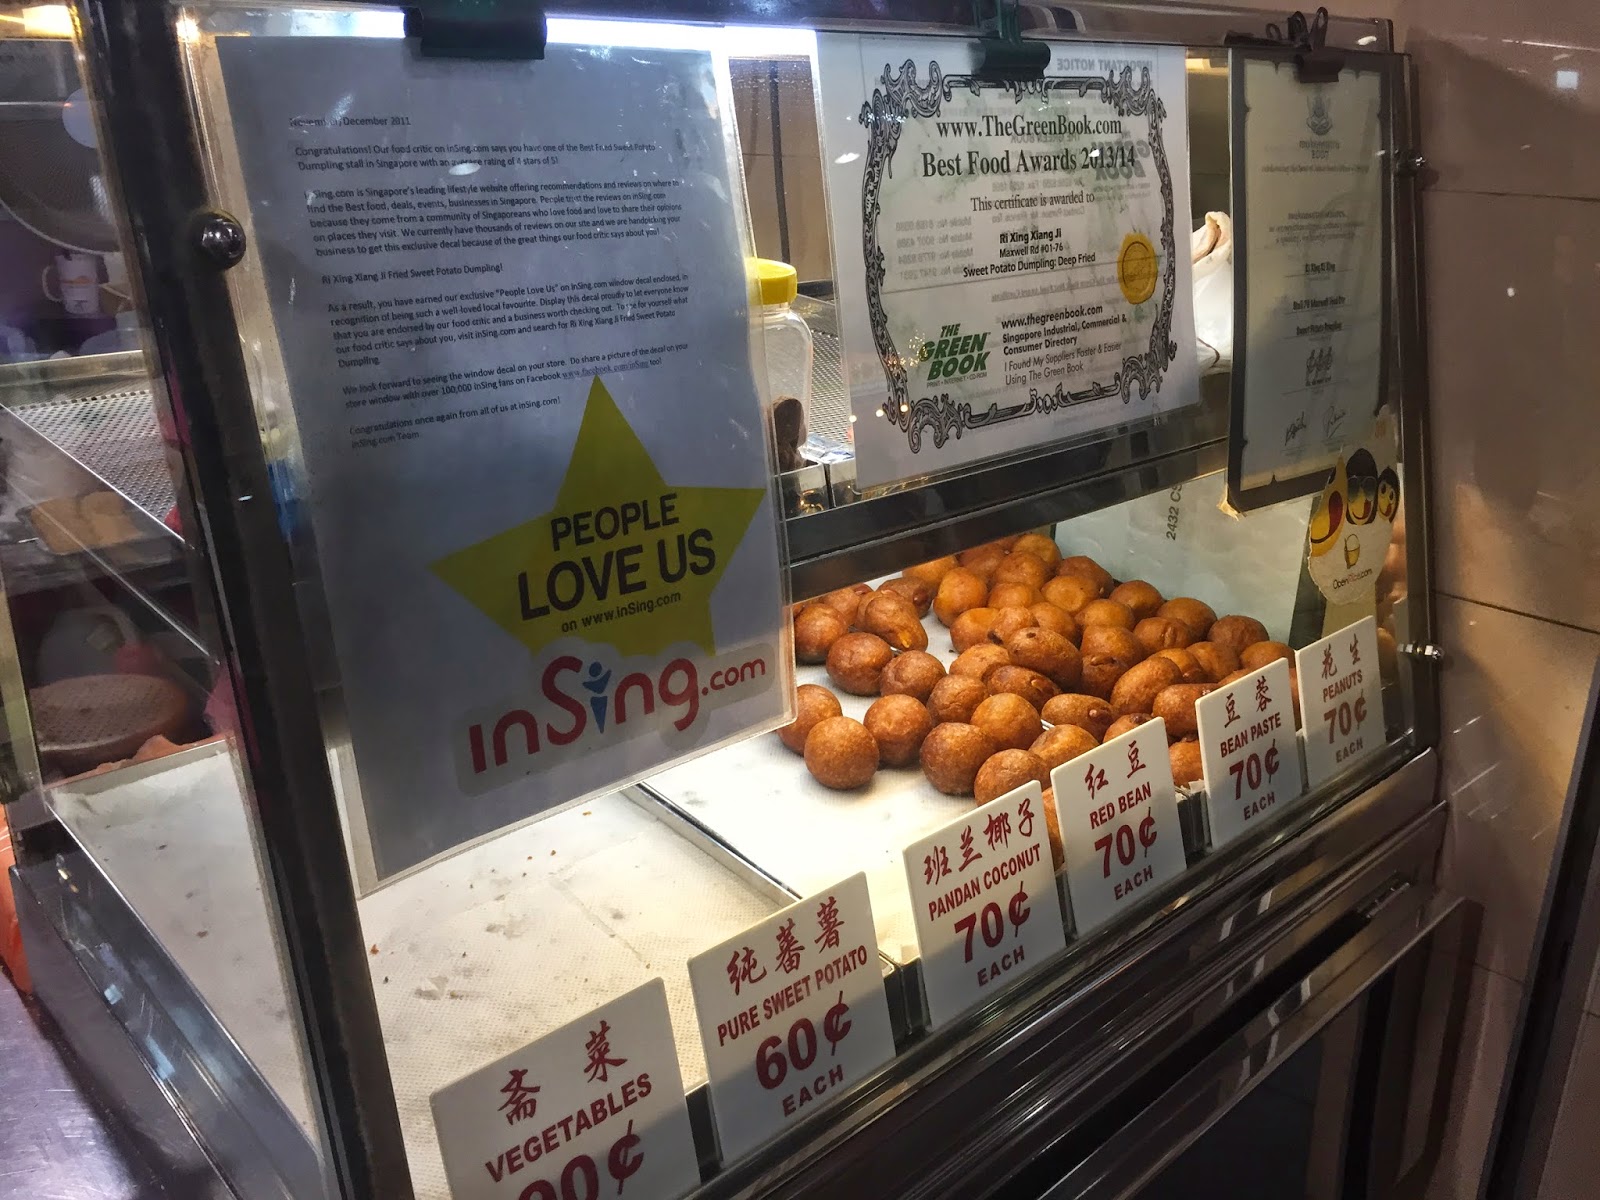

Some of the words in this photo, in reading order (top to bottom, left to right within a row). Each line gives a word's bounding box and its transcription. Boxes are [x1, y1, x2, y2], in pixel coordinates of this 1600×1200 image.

[342, 115, 388, 125] December
[390, 115, 410, 125] 2011
[936, 115, 1122, 138] www.TheGreenBook.com
[294, 144, 372, 158] Congratulations!
[391, 144, 412, 154] food
[412, 144, 433, 154] critic
[578, 141, 594, 151] Best
[298, 159, 344, 172] Dumpling
[345, 158, 364, 169] stall
[376, 158, 418, 170] Singapore
[419, 157, 438, 167] with
[483, 156, 506, 168] rating
[922, 152, 962, 177] Best
[968, 150, 1011, 174] Food
[1016, 148, 1076, 173] Awards
[1081, 146, 1135, 168] 2013/14
[365, 184, 414, 198] Singapore's
[415, 184, 446, 196] leading
[479, 182, 508, 192] website
[509, 181, 539, 193] offering
[540, 179, 602, 190] recommendations
[971, 196, 992, 211] This
[994, 194, 1038, 210] certificate
[1040, 193, 1047, 207] is
[1050, 190, 1083, 205] awarded
[1086, 192, 1094, 202] to
[309, 217, 348, 227] because
[426, 210, 471, 222] community
[345, 201, 365, 211] Best
[327, 231, 356, 243] places
[475, 221, 513, 233] thousands
[523, 220, 553, 231] reviews
[401, 240, 438, 251] exclusive
[461, 237, 493, 247] because
[517, 233, 538, 246] great
[538, 232, 562, 244] things
[1000, 233, 1008, 243] Ri
[1010, 232, 1029, 244] Xing
[1030, 230, 1053, 241] Xiang
[1055, 228, 1061, 238] Ji
[964, 266, 988, 277] Sweet
[990, 264, 1015, 274] Potato
[1018, 259, 1056, 271] Dumpling:
[1058, 257, 1076, 268] Deep
[1078, 253, 1095, 263] Fried
[1000, 246, 1028, 258] Maxwell
[1030, 246, 1039, 254] Rd
[1041, 243, 1063, 254] #01-76
[321, 273, 331, 283] Ri
[332, 272, 354, 284] Xing
[354, 271, 379, 282] Xiang
[380, 269, 387, 280] Ji
[388, 268, 409, 279] Fried
[410, 267, 435, 278] Sweet
[436, 265, 463, 276] Potato
[463, 262, 504, 276] Dumpling!
[459, 288, 495, 300] exclusive
[495, 285, 526, 297] "People
[526, 284, 545, 294] Love
[608, 275, 634, 287] window
[330, 312, 380, 326] recognition
[539, 294, 566, 307] Display
[581, 290, 600, 302] decal
[514, 311, 546, 322] business
[546, 306, 568, 318] worth
[569, 304, 600, 316] checking
[532, 319, 557, 332] search
[635, 309, 655, 321] Sweet
[655, 308, 676, 319] Potato
[1002, 305, 1103, 329] www.thegreenbook.com
[941, 323, 960, 338] THE
[1003, 330, 1042, 343] Singapore
[1044, 322, 1080, 336] Industrial,
[1082, 314, 1120, 330] Commercial
[1122, 314, 1127, 322] &
[920, 332, 987, 362] GREEN
[1004, 342, 1042, 355] Consumer
[1045, 336, 1077, 348] Directory
[1009, 357, 1031, 371] Found
[1033, 357, 1043, 366] My
[1046, 351, 1075, 365] Suppliers
[1077, 347, 1095, 357] Faster
[1098, 345, 1102, 353] &
[1104, 342, 1122, 353] Easier
[463, 366, 495, 379] window
[496, 362, 516, 374] decal
[606, 348, 630, 362] picture
[927, 351, 991, 380] BOOK
[1005, 374, 1026, 385] Using
[1029, 370, 1041, 381] The
[1044, 366, 1064, 378] Green
[1067, 363, 1083, 375] Book
[441, 381, 472, 395] 100,000
[473, 379, 498, 391] inSing
[526, 369, 561, 383] Facebook
[414, 414, 435, 425] once
[435, 410, 458, 423] again
[551, 493, 680, 552] PEOPLE
[1166, 506, 1179, 540] 2432
[518, 545, 646, 621] LOVE
[658, 528, 716, 583] US
[562, 620, 577, 633] on
[582, 592, 681, 628] www.inSing.com
[1322, 634, 1360, 679] 花生
[1323, 670, 1363, 702] PEANUTS
[469, 656, 765, 774] inSing.com
[1224, 676, 1272, 728] 豆蓉
[1324, 689, 1367, 744] 70¢
[1220, 730, 1248, 758] BEAN
[1251, 712, 1281, 741] PASTE
[1336, 737, 1363, 763] EACH
[1085, 740, 1146, 800] 红豆
[1229, 738, 1279, 800] 70¢
[1090, 804, 1115, 829] RED
[1118, 782, 1151, 814] BEAN
[1244, 792, 1275, 820] EACH
[924, 798, 1034, 885] 班兰椰子
[1095, 807, 1157, 879] 70¢
[928, 878, 981, 921] PANDAN
[984, 843, 1041, 890] COCONUT
[1114, 865, 1153, 900] EACH
[954, 881, 1031, 963] 70¢
[727, 896, 844, 996] 纯蕃薯
[977, 945, 1025, 987] EACH
[717, 1006, 760, 1047] PURE
[763, 975, 811, 1020] SWEET
[816, 945, 867, 990] POTATO
[756, 991, 851, 1090] 60¢
[498, 1020, 628, 1125] 斋菜
[782, 1064, 843, 1117] EACH
[486, 1073, 652, 1183] VEGETABLES
